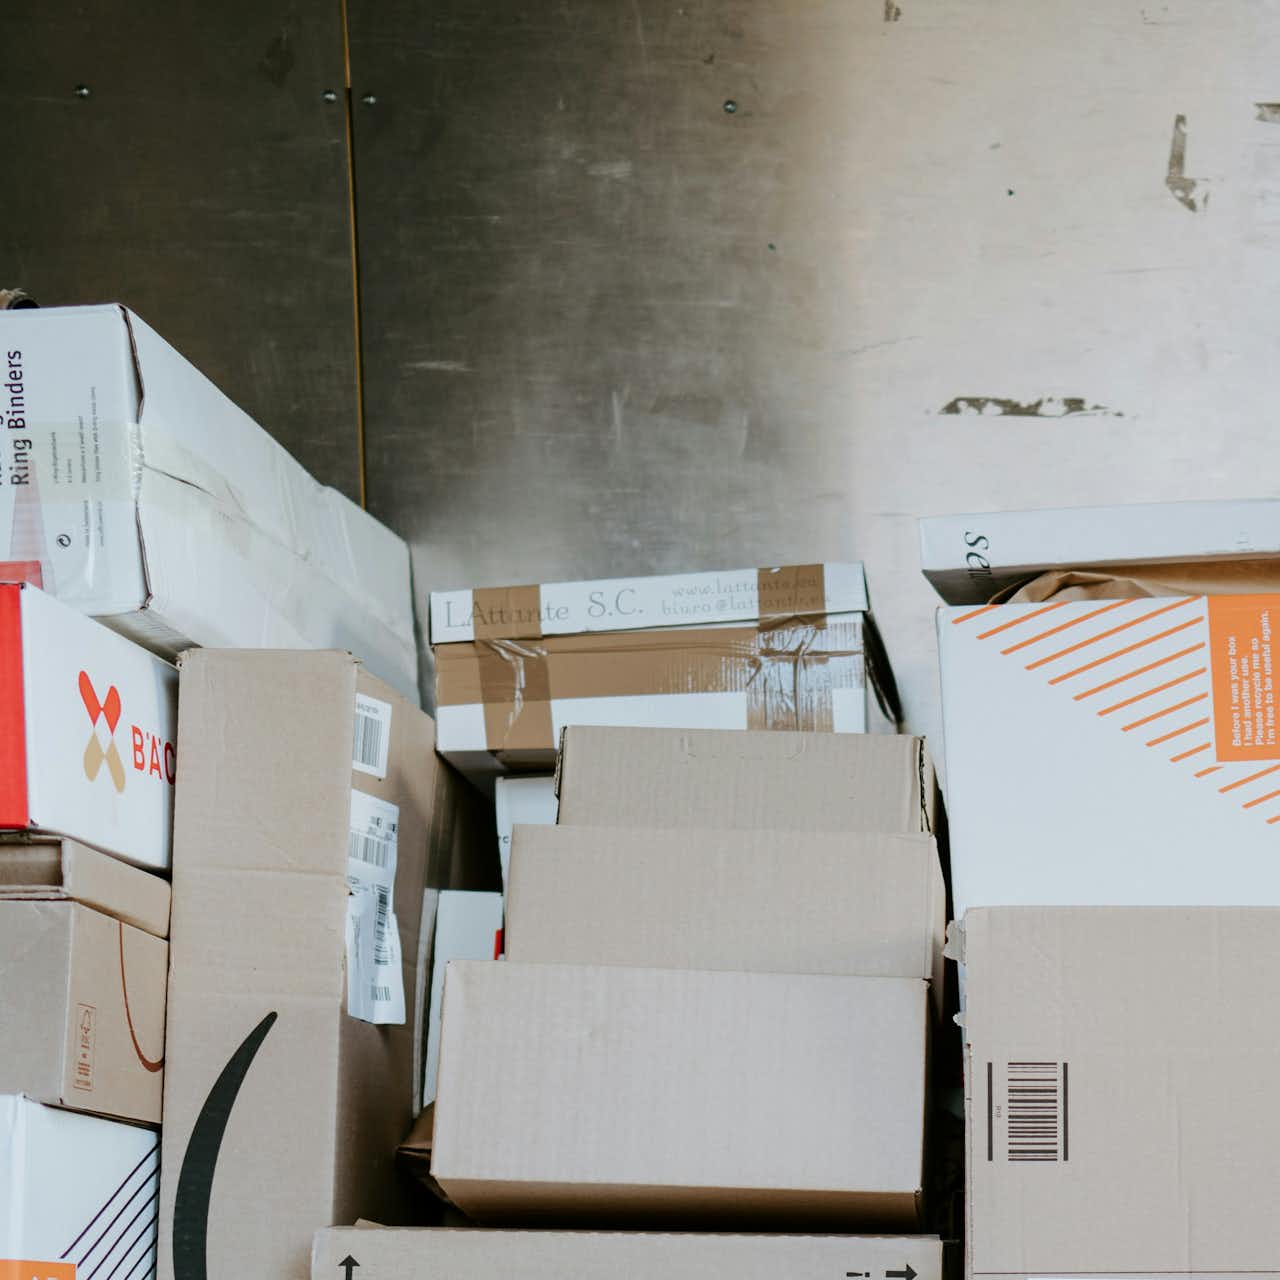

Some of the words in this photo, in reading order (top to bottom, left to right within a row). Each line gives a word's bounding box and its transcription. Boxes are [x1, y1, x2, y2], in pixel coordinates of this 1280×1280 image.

[7, 349, 27, 431] Binders
[11, 437, 33, 486] Ring
[1260, 610, 1271, 641] again.
[1228, 636, 1237, 656] box
[1262, 644, 1272, 674] useful
[1231, 657, 1240, 681] your
[1241, 656, 1249, 676] use.
[1252, 654, 1260, 669] me
[1242, 679, 1251, 717] another
[1253, 672, 1263, 709] recycle
[1232, 713, 1241, 746] Before
[1243, 721, 1252, 740] had
[1255, 712, 1264, 745] Please
[1265, 706, 1274, 726] free
